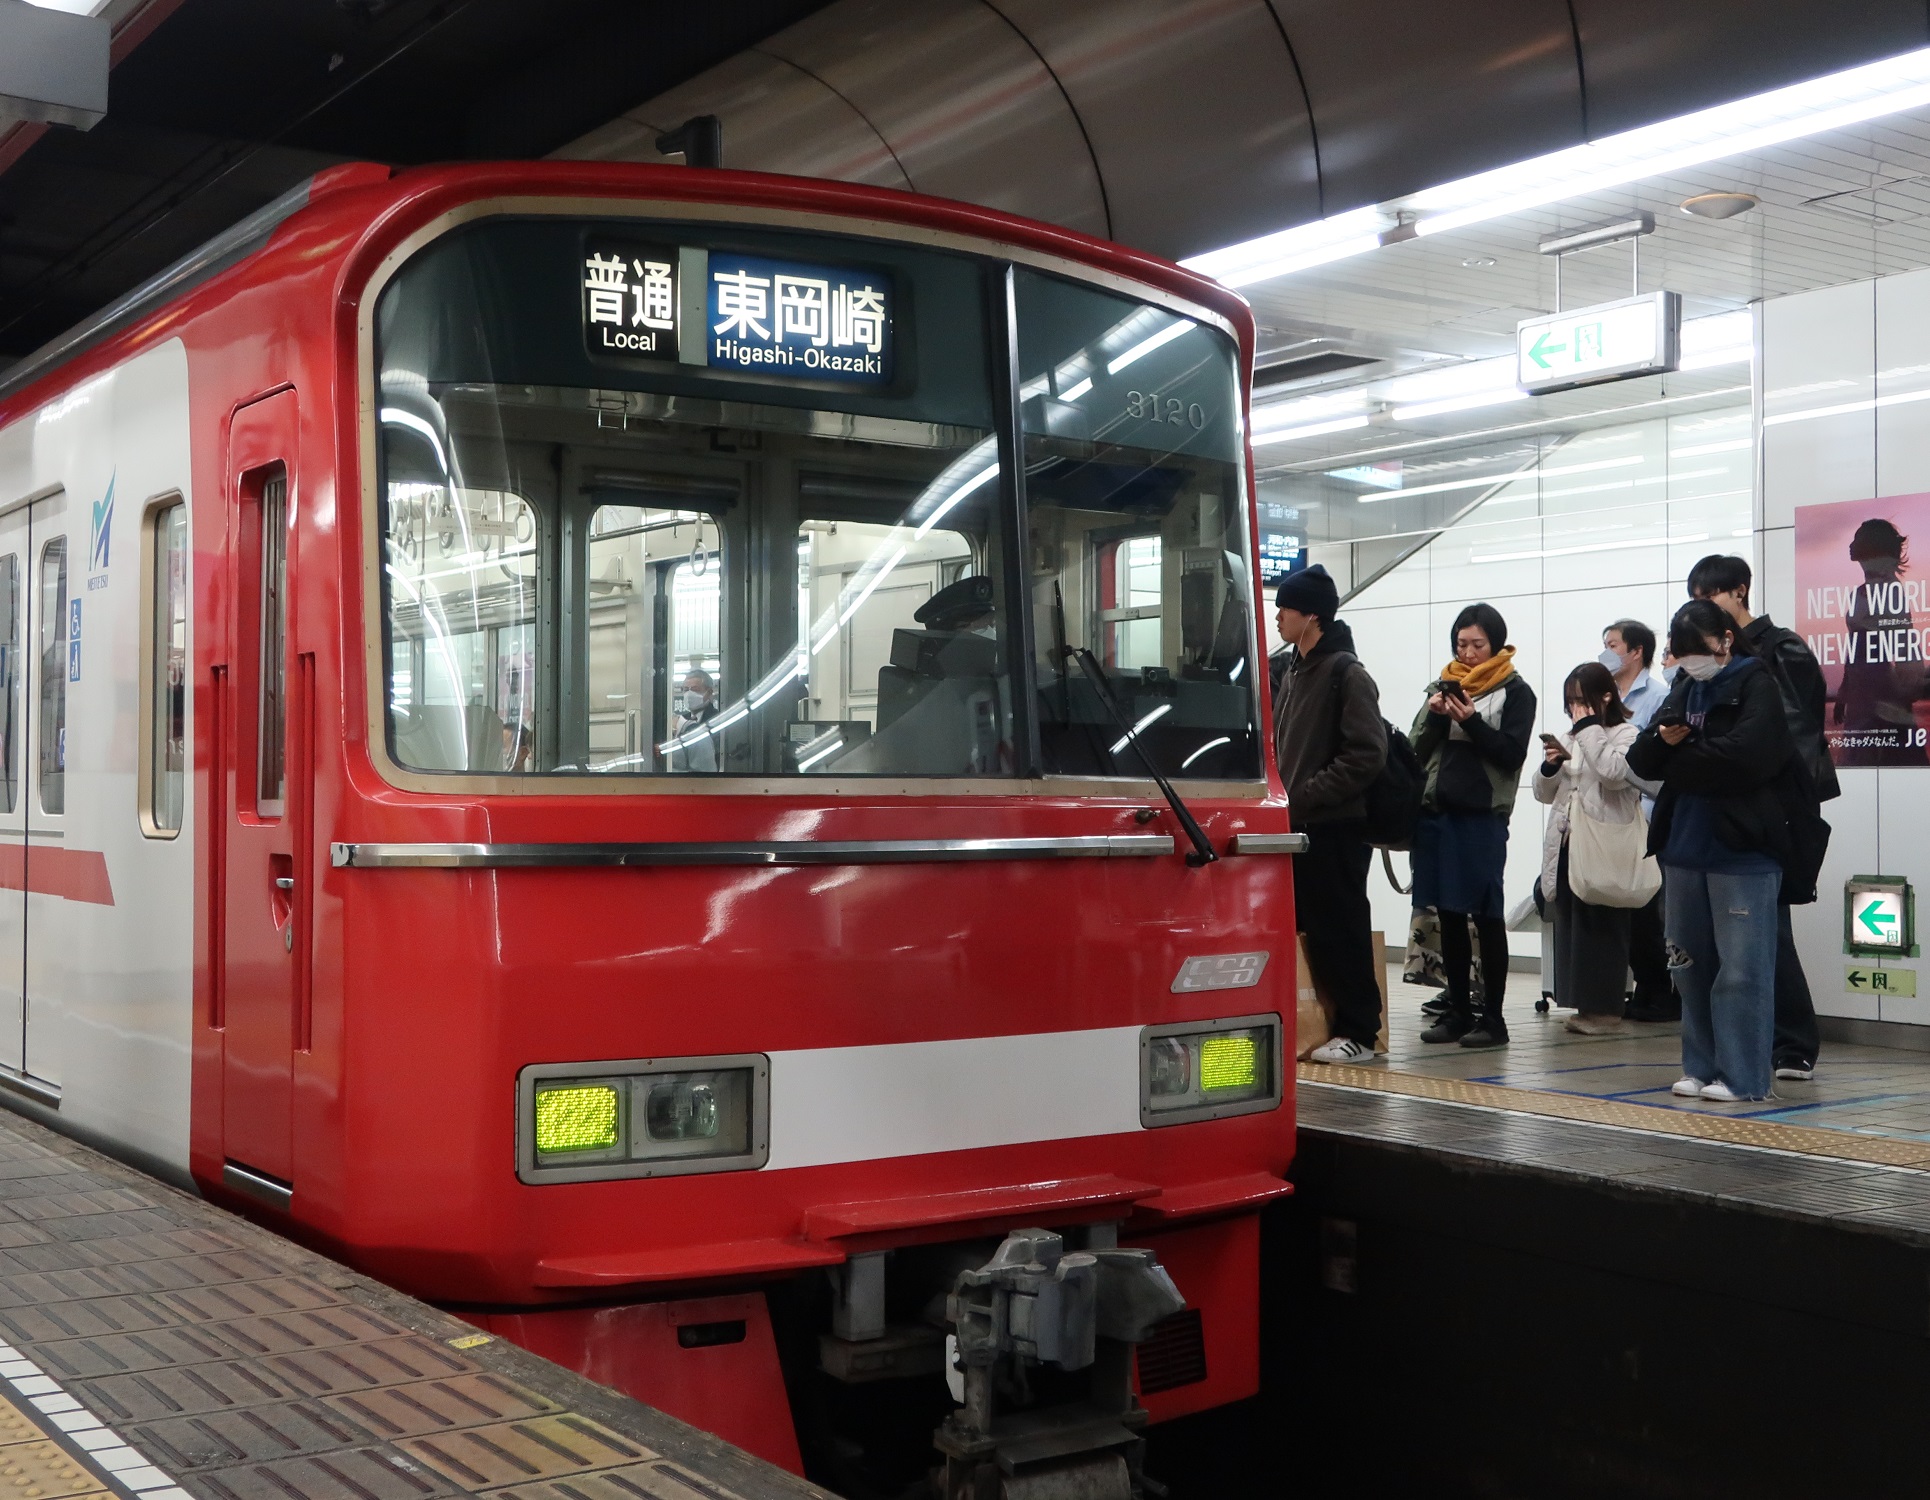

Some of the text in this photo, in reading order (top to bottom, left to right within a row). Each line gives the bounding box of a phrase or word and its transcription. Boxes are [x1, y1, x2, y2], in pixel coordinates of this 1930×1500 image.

[585, 252, 674, 331] 普通
[713, 269, 886, 354] 東岡崎
[603, 327, 656, 351] Local
[715, 339, 882, 375] Higashi-Okazaki
[1126, 390, 1206, 431] 3120
[1807, 579, 1930, 619] NEW WORL
[1807, 625, 1930, 665] NEW ENERG
